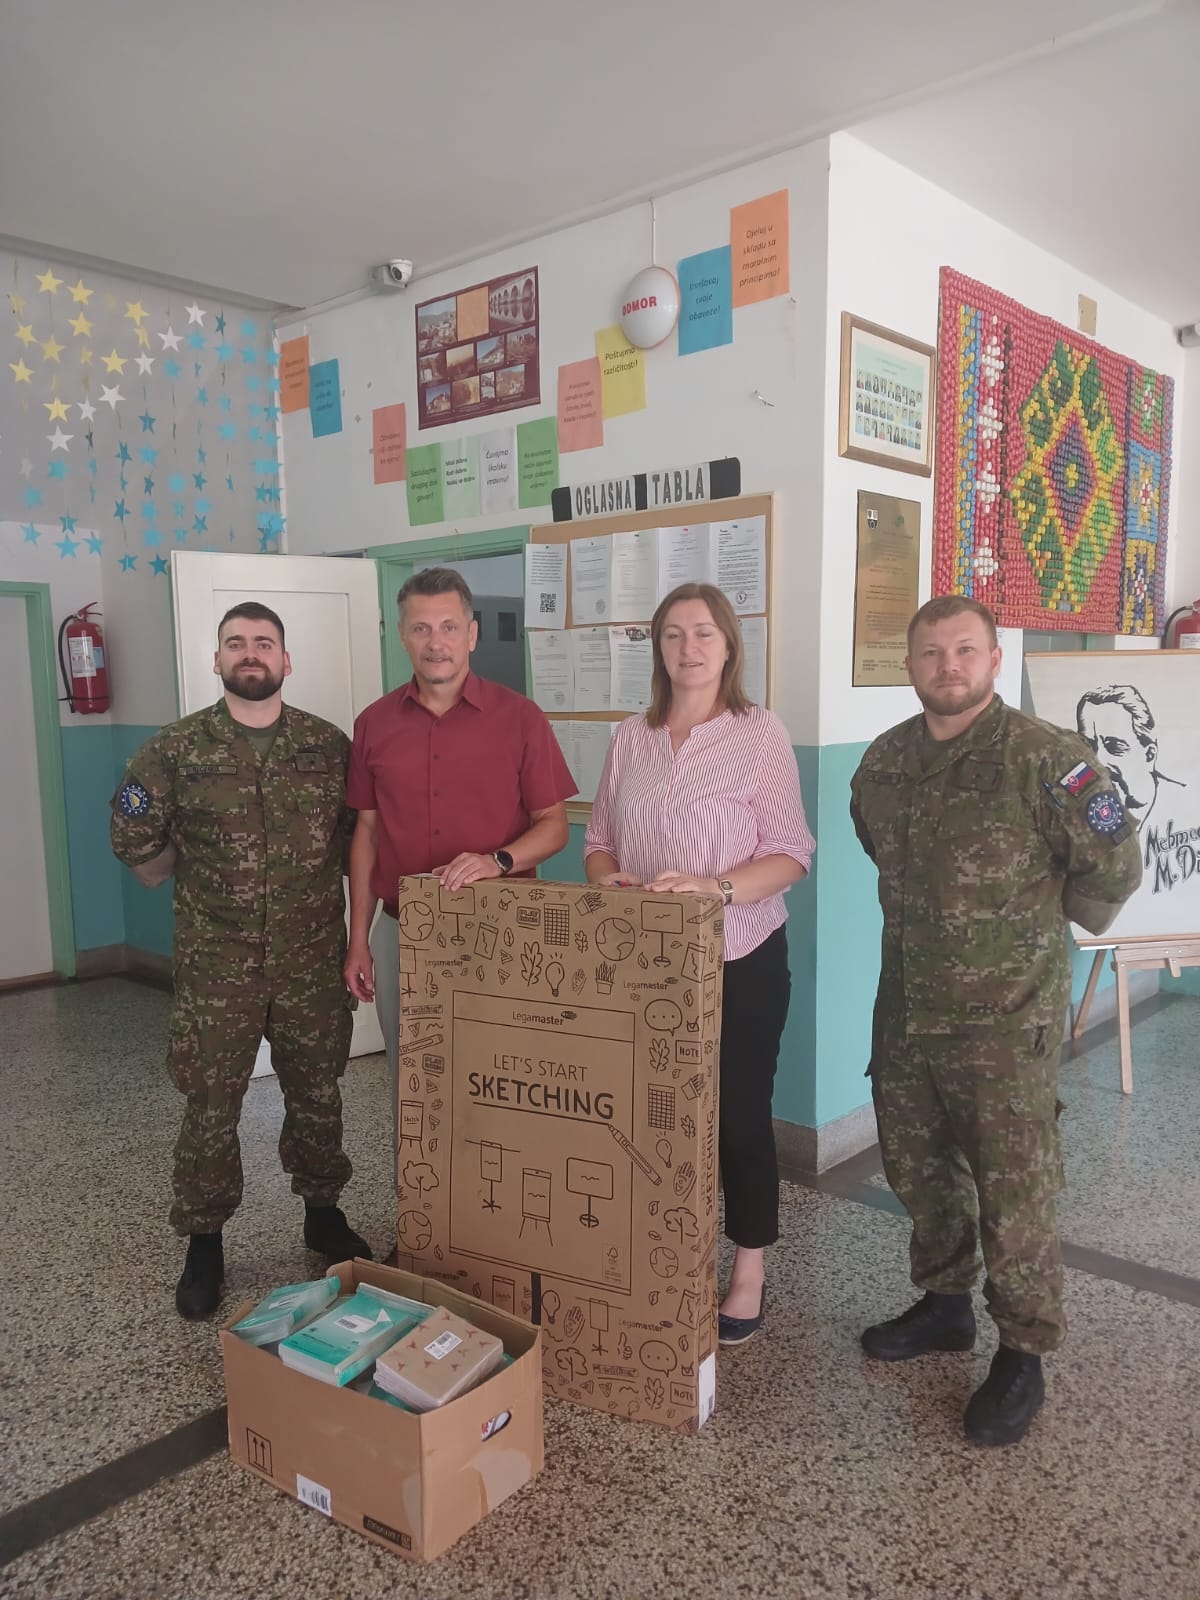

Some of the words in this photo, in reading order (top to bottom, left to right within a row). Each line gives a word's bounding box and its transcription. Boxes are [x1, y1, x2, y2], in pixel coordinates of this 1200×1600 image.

[743, 242, 766, 254] skladu
[768, 239, 776, 248] sa
[742, 255, 777, 271] moralnim
[739, 267, 780, 288] principima!
[622, 296, 657, 317] ODMOR
[695, 293, 713, 305] svoje
[605, 347, 635, 361] Poštujmo
[575, 479, 632, 516] OGLASNA
[651, 467, 705, 505] TABLA
[424, 959, 464, 968] Legamaster
[623, 980, 668, 991] Legamaster
[512, 1010, 564, 1026] Legamaster
[679, 1046, 700, 1058] NOTE
[493, 1053, 533, 1075] LET'S
[538, 1060, 588, 1083] START
[468, 1072, 614, 1120] SKETCHING
[705, 1110, 714, 1217] SKETCHING
[618, 1319, 664, 1332] Legamaster
